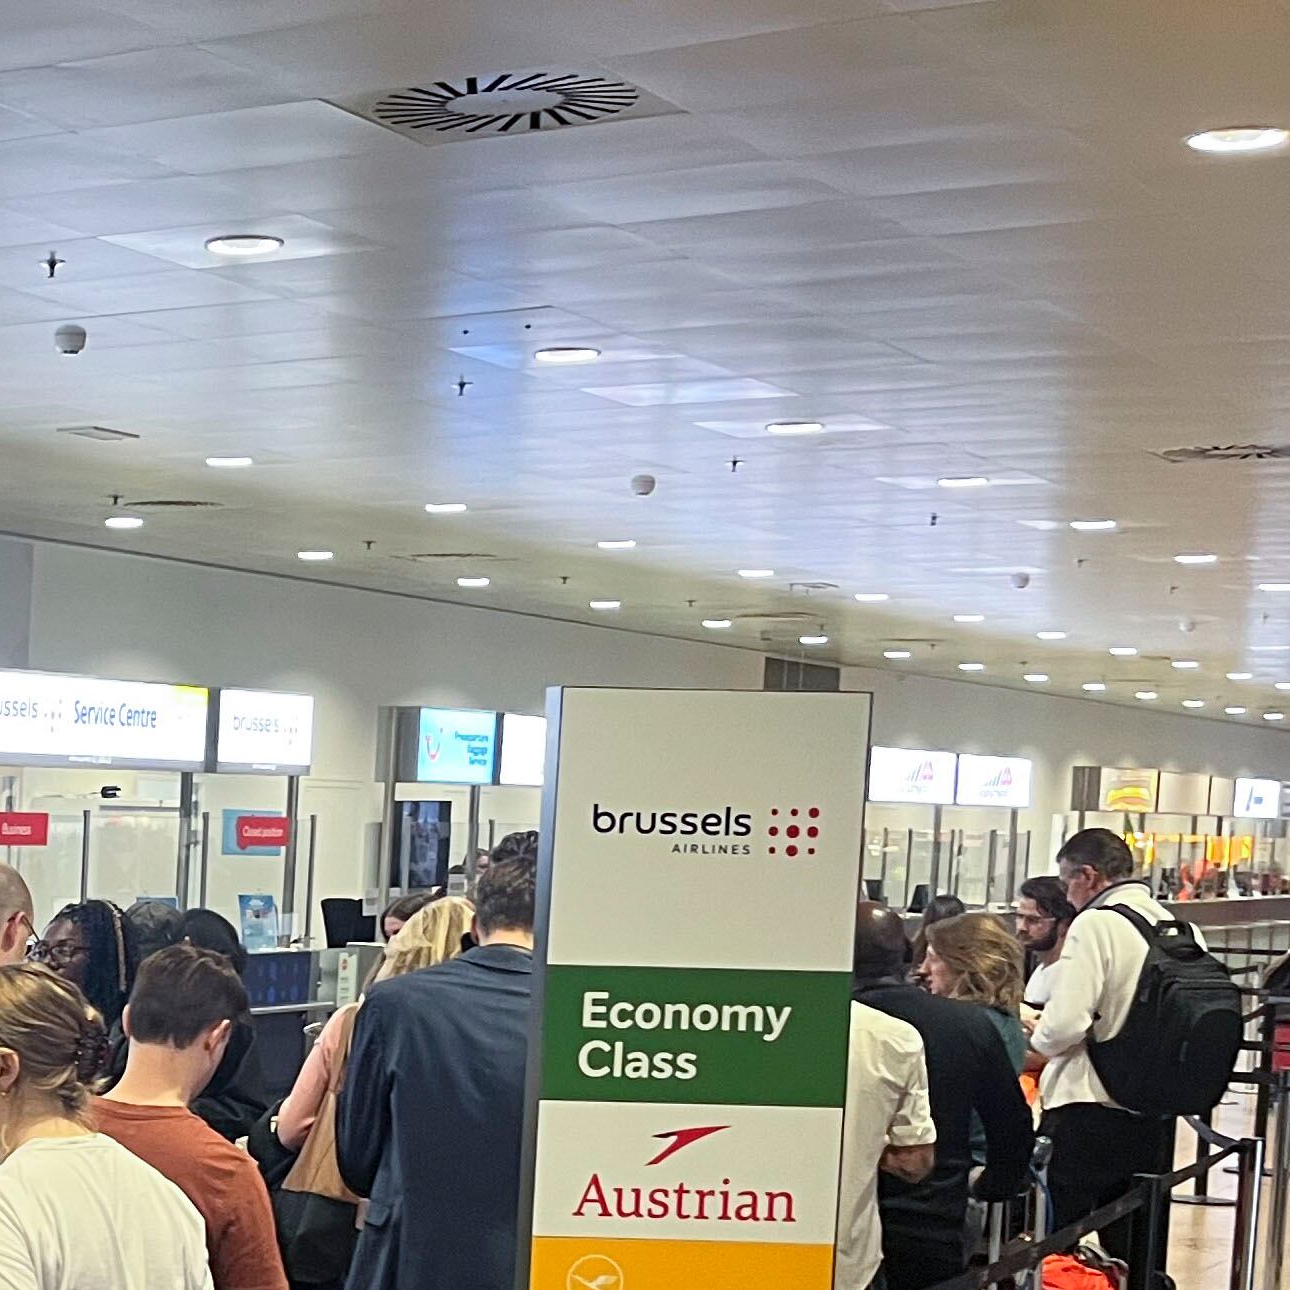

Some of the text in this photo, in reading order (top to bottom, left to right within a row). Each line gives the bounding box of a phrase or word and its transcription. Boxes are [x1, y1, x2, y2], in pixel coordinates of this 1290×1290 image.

[74, 700, 157, 728] Service Centre
[592, 803, 752, 837] brussels
[671, 843, 751, 855] AIRLINES
[582, 991, 792, 1042] Economy
[578, 1040, 698, 1080] Class
[572, 1173, 796, 1222] Austrian
